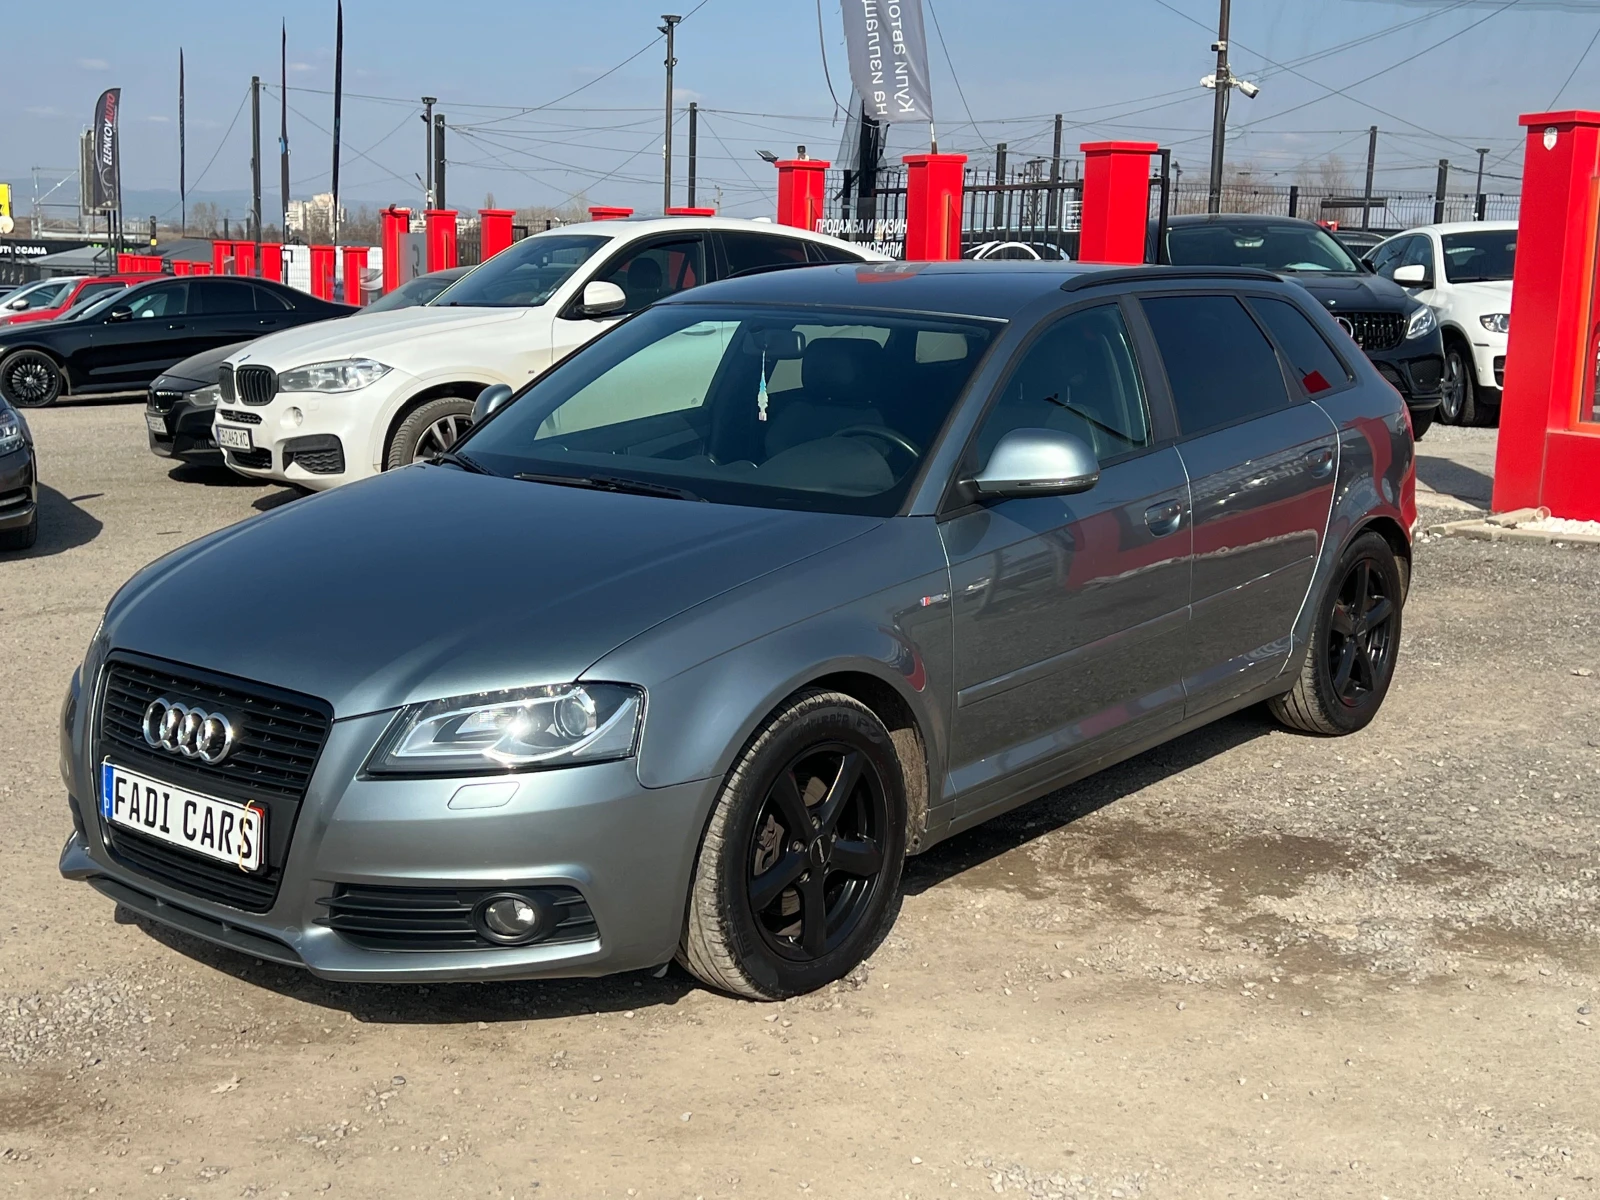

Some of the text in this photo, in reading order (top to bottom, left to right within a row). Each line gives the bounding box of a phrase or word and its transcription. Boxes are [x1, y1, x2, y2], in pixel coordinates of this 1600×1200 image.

[815, 218, 908, 237] ПРОДАЖБА И ЛИЗИН
[115, 777, 252, 859] FADI CARS
